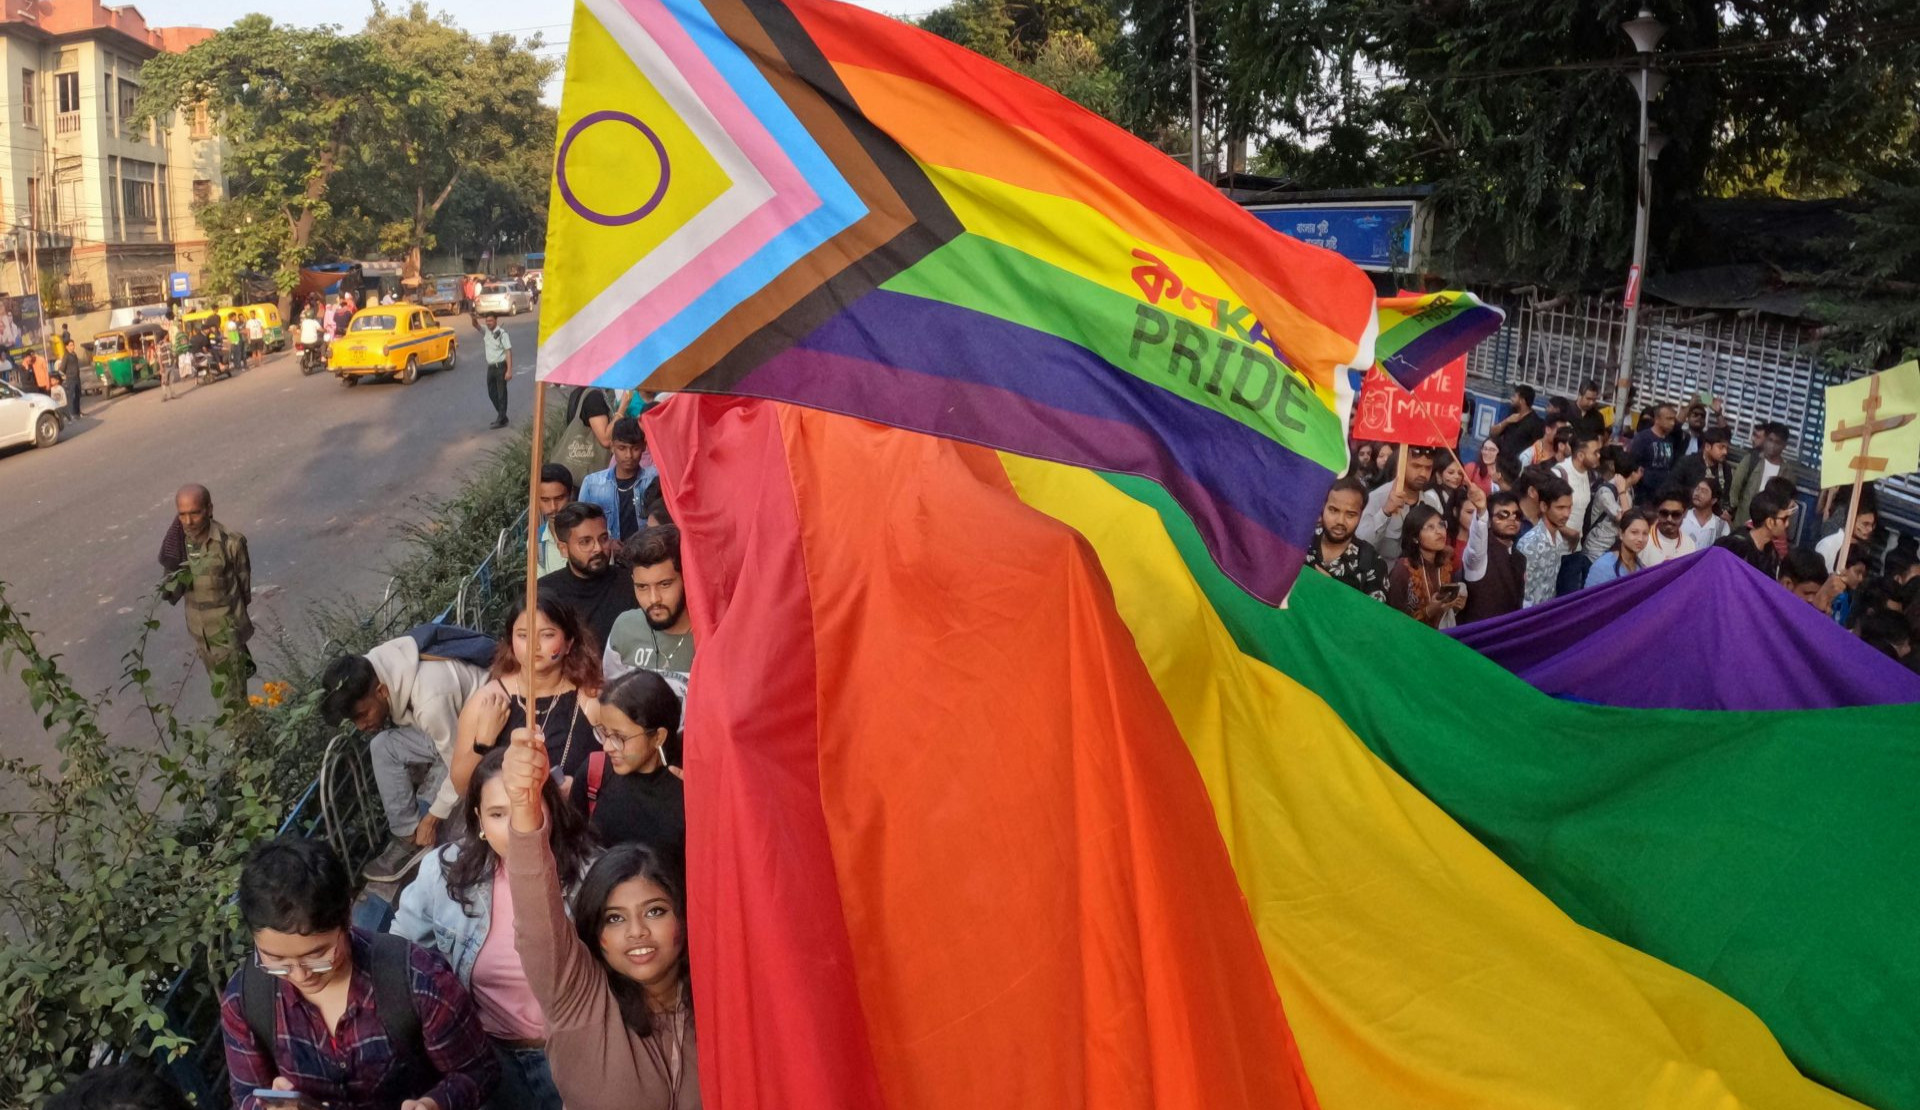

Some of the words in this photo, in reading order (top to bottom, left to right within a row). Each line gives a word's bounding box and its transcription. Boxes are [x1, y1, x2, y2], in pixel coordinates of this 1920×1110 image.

[1128, 303, 1309, 434] PRIDE
[1383, 386, 1399, 434] I
[1397, 399, 1460, 422] MATTER
[634, 647, 654, 667] 07
